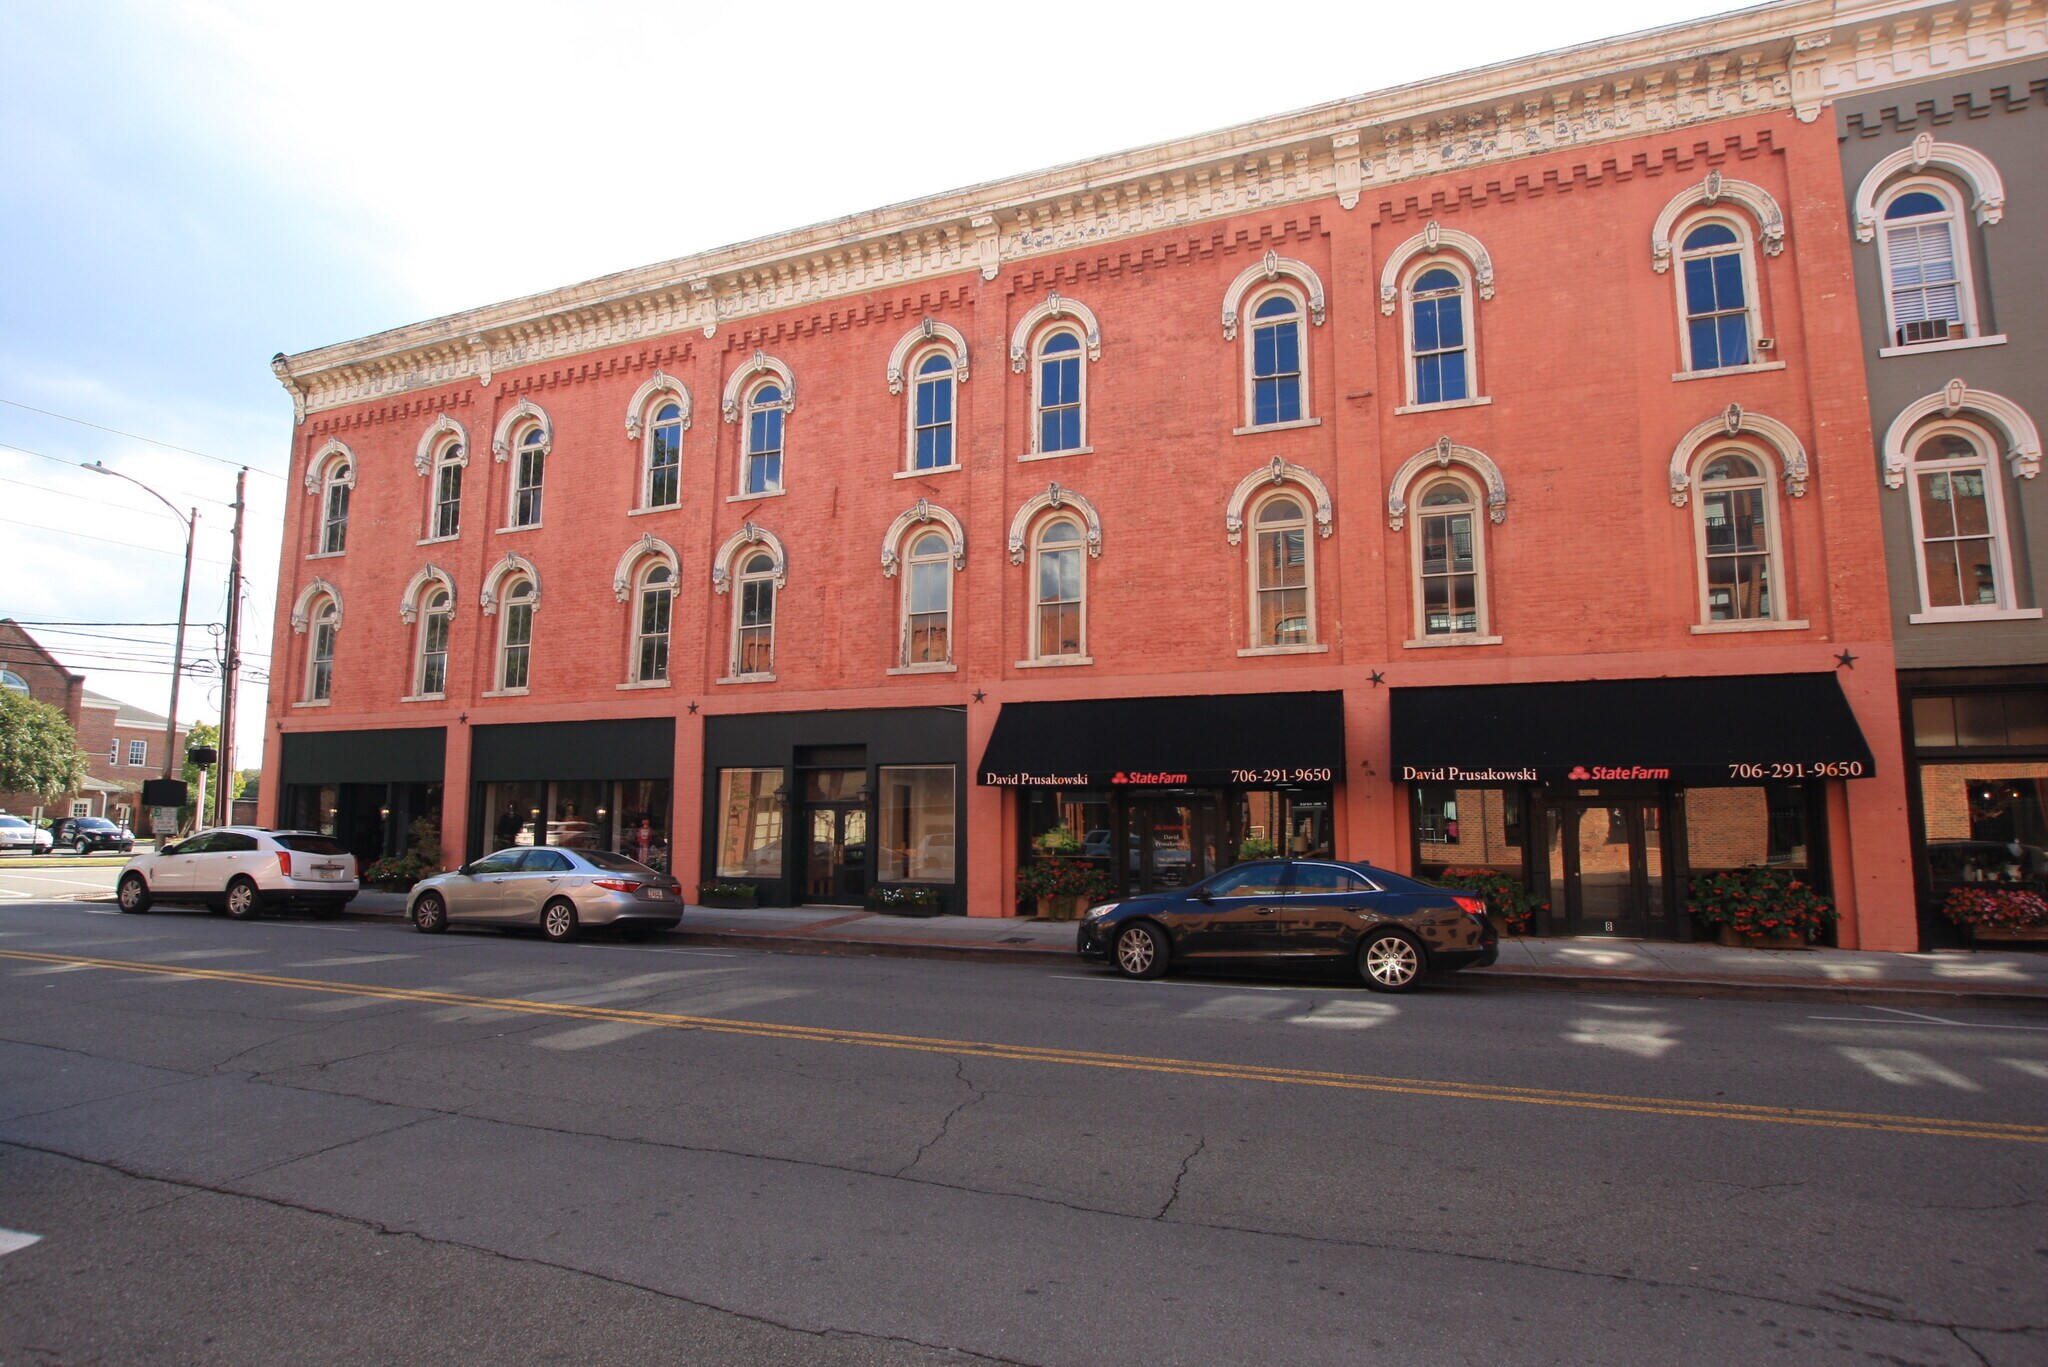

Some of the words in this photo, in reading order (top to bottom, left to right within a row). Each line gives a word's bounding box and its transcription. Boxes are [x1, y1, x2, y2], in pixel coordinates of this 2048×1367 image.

[1231, 768, 1331, 783] 706-291-9650
[1403, 767, 1445, 781] David
[1448, 767, 1538, 781] Prusakowski
[1728, 762, 1862, 778] 706-291-9650
[986, 772, 1018, 785] David
[1020, 772, 1089, 785] Prusakowski
[1606, 922, 1612, 931] 8
